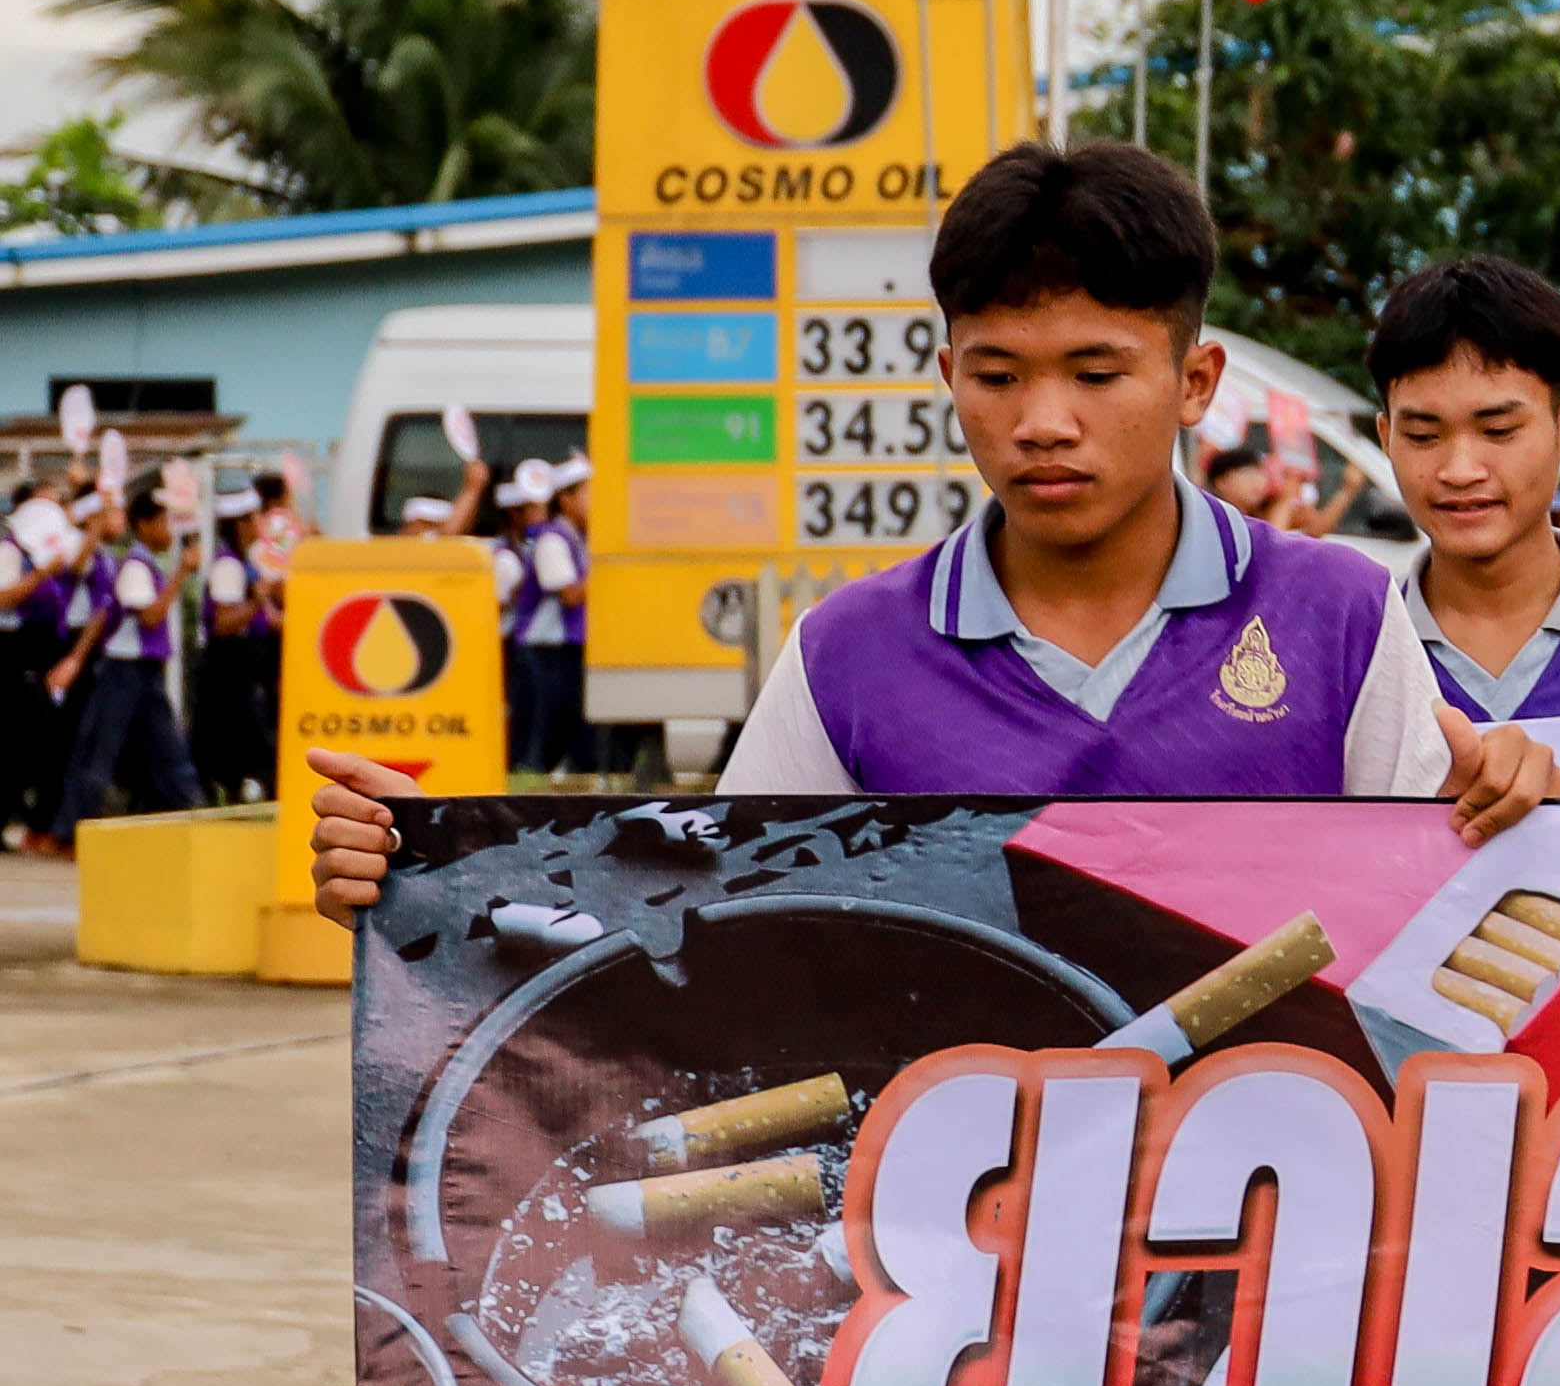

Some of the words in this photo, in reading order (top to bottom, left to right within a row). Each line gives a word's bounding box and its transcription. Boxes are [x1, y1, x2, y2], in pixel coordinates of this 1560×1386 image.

[655, 164, 855, 205] COSMO
[876, 163, 952, 203] OIL
[802, 316, 951, 375] 33.9
[298, 712, 416, 738] COSMO
[426, 712, 471, 737] OIL
